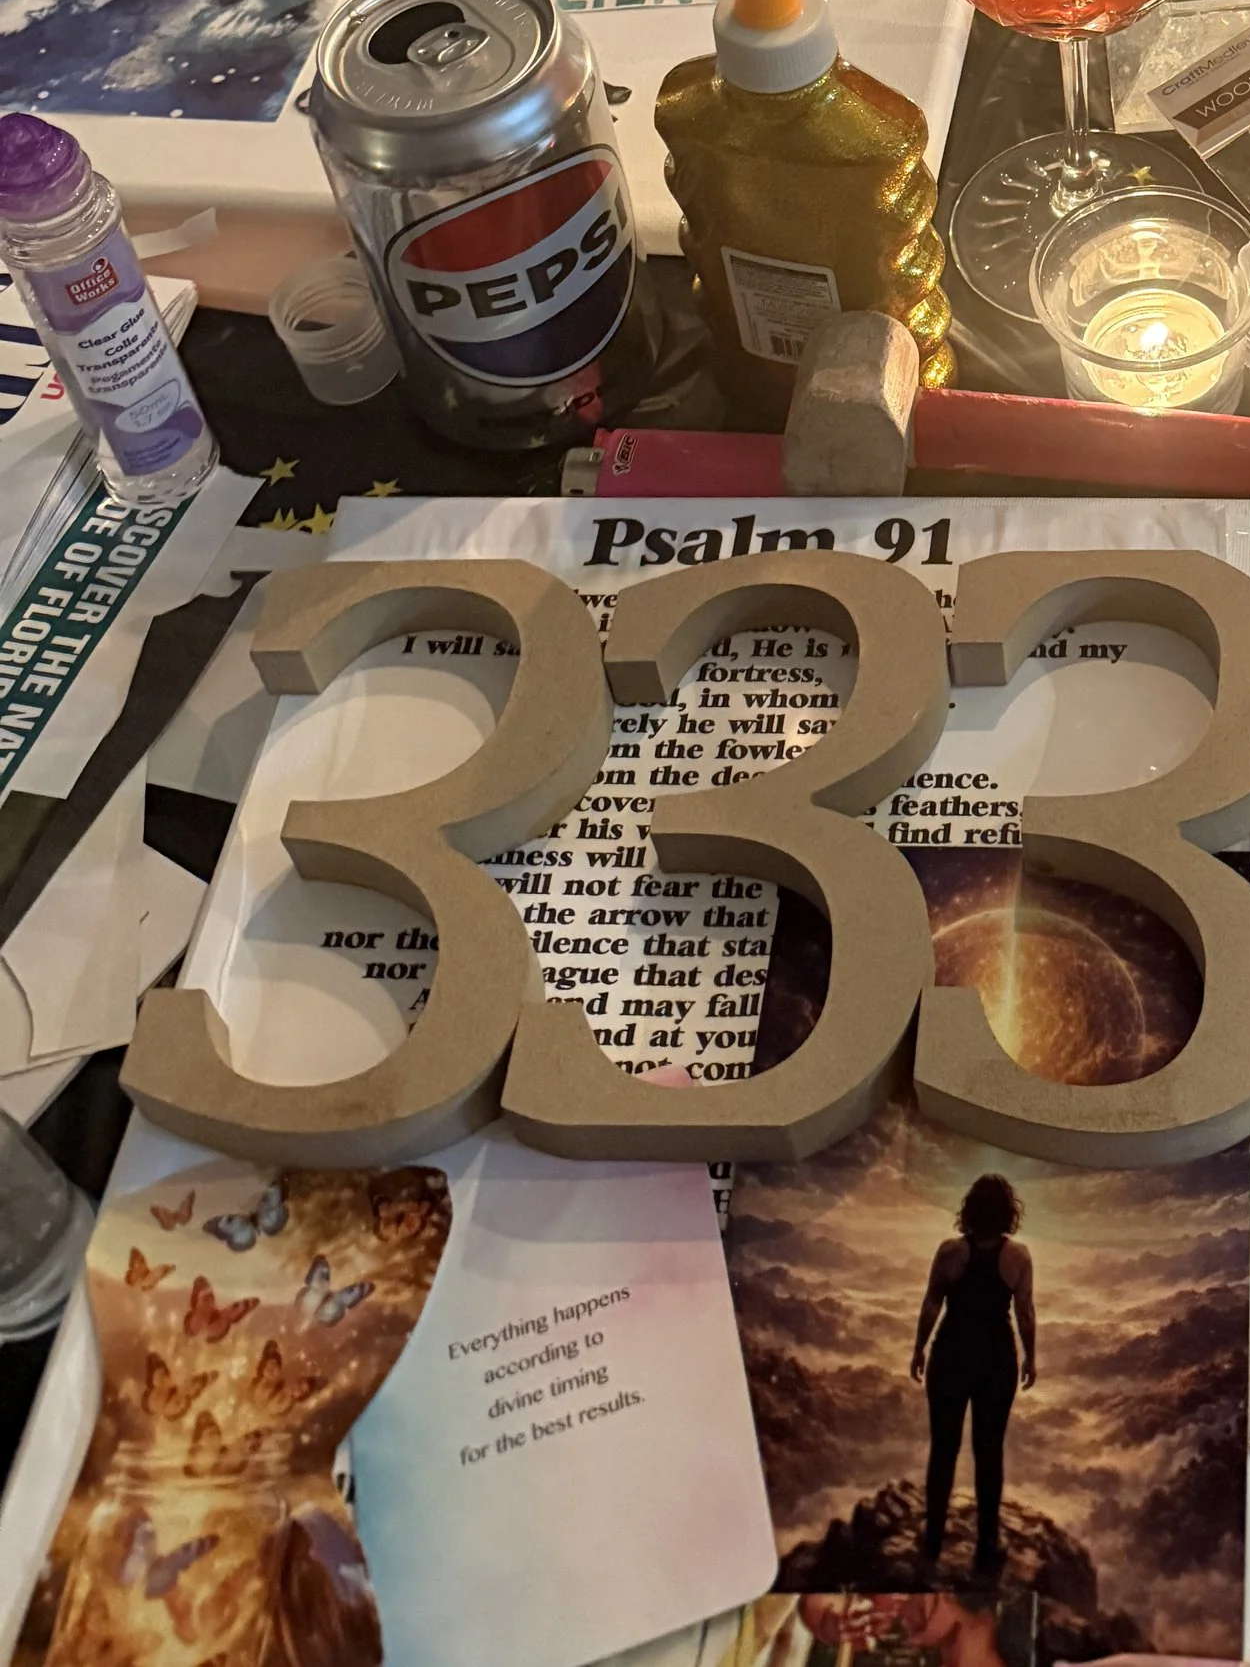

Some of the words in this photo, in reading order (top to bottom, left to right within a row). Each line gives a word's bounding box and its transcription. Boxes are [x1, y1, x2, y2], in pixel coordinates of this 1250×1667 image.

[68, 269, 112, 295] Office
[74, 277, 116, 304] Works
[77, 330, 119, 350] Clear
[119, 307, 146, 335] Glue
[77, 321, 160, 374] Transparente
[103, 333, 140, 357] Colle
[582, 514, 836, 567] Psalm
[873, 517, 953, 566] 91
[54, 540, 103, 583] OF
[68, 498, 175, 625] SCOVER
[402, 635, 417, 655] I
[427, 635, 484, 656] will
[750, 638, 794, 659] He
[804, 637, 829, 658] is
[1078, 643, 1128, 664] my
[20, 634, 92, 697] THE
[695, 662, 824, 687] fortress,
[698, 688, 731, 709] in
[742, 688, 840, 709] whom
[611, 713, 669, 739] rely
[676, 713, 716, 735] he
[727, 713, 786, 735] will
[653, 738, 705, 760] the
[648, 765, 700, 787] the
[575, 817, 624, 841] his
[887, 821, 953, 846] find
[586, 845, 646, 868] will
[561, 877, 623, 898] not
[630, 873, 701, 899] fear
[711, 876, 764, 900] the
[523, 902, 576, 926] the
[587, 906, 692, 928] arrow
[702, 905, 771, 928] that
[320, 929, 386, 950] nor
[530, 930, 631, 956] ilence
[641, 934, 713, 958] that
[721, 935, 772, 958] sta
[362, 960, 427, 980] nor
[541, 966, 620, 991] ague
[632, 963, 703, 988] that
[712, 965, 768, 987] des
[618, 996, 697, 1025] may
[704, 992, 762, 1019] fall
[648, 1026, 685, 1048] at
[695, 1028, 758, 1056] you
[685, 1060, 752, 1081] com
[447, 1313, 549, 1361] Everything
[552, 1286, 632, 1324] happens
[483, 1339, 580, 1385] according
[583, 1330, 605, 1353] to
[487, 1384, 545, 1420] divine
[549, 1364, 610, 1398] timing
[459, 1444, 491, 1467] for
[494, 1430, 526, 1456] the
[531, 1413, 574, 1441] best
[578, 1388, 646, 1425] results.
